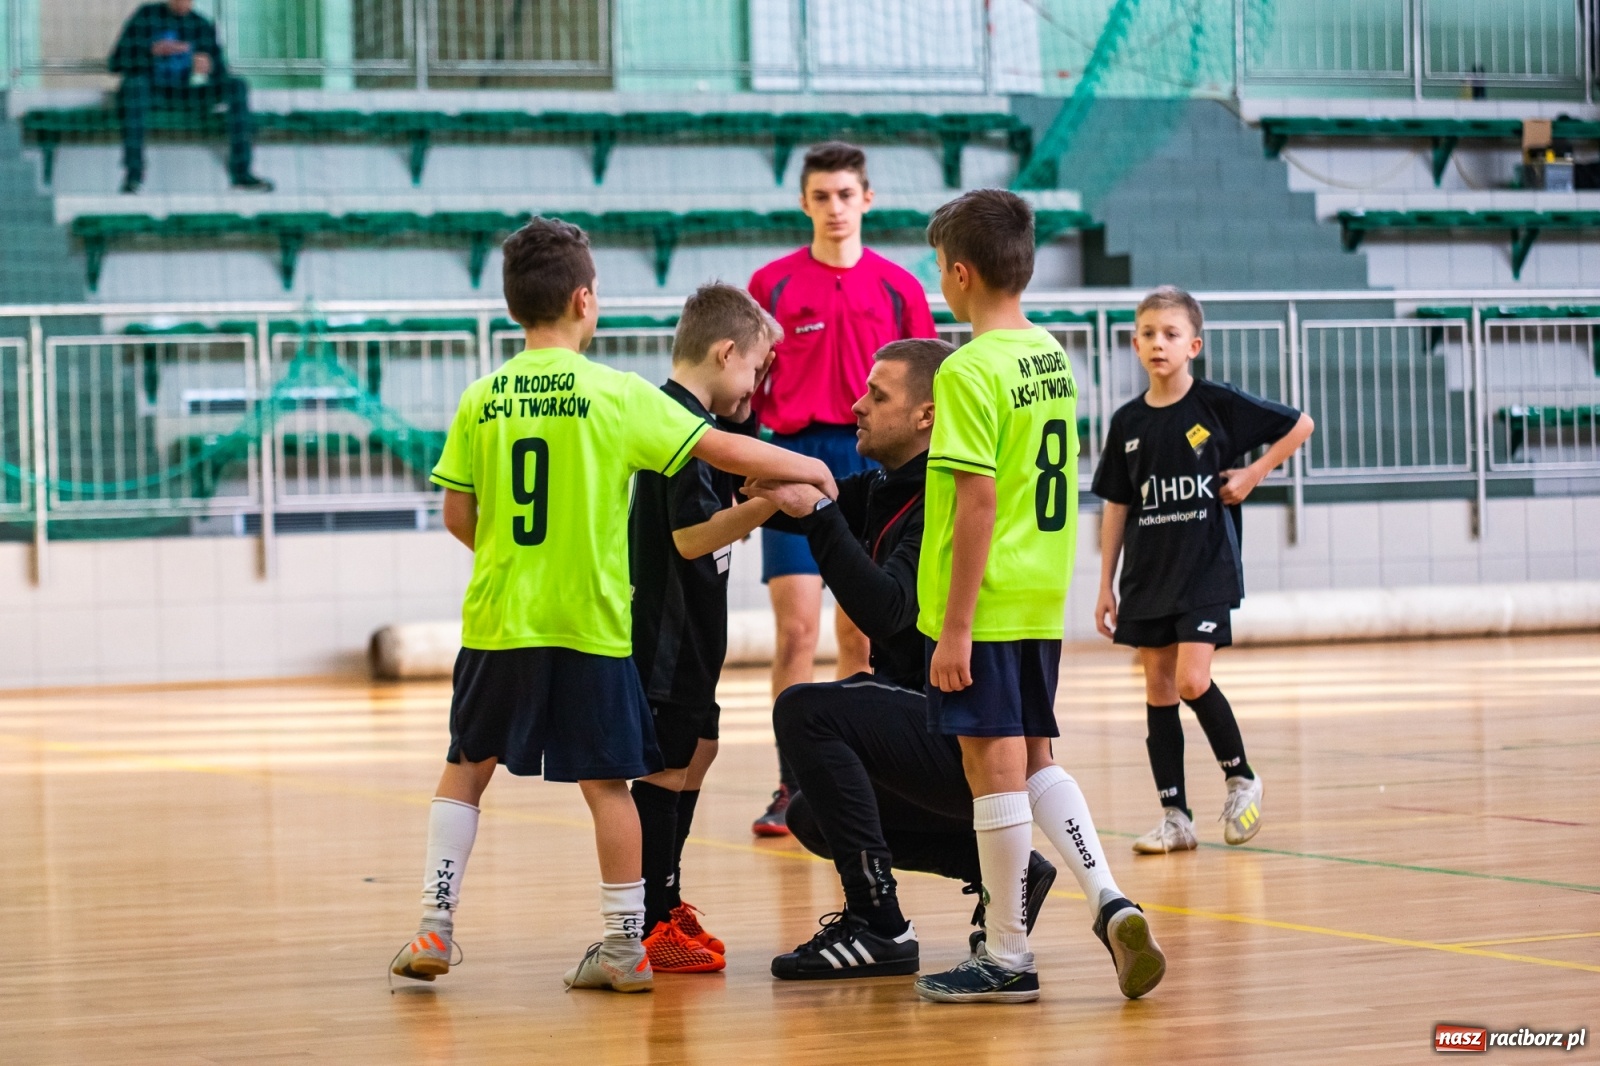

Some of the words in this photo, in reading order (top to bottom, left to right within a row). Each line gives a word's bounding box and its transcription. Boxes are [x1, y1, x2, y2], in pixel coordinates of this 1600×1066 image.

[1018, 357, 1032, 379] AP
[492, 375, 508, 394] AP
[514, 372, 575, 394] MŁODEGO
[519, 393, 591, 419] TWORKÓW
[1035, 419, 1067, 532] 8
[1161, 475, 1214, 503] HDK
[512, 437, 549, 546] 9
[1138, 508, 1208, 527] hdkdeveloper.pl
[1065, 818, 1096, 870] TWORKOW
